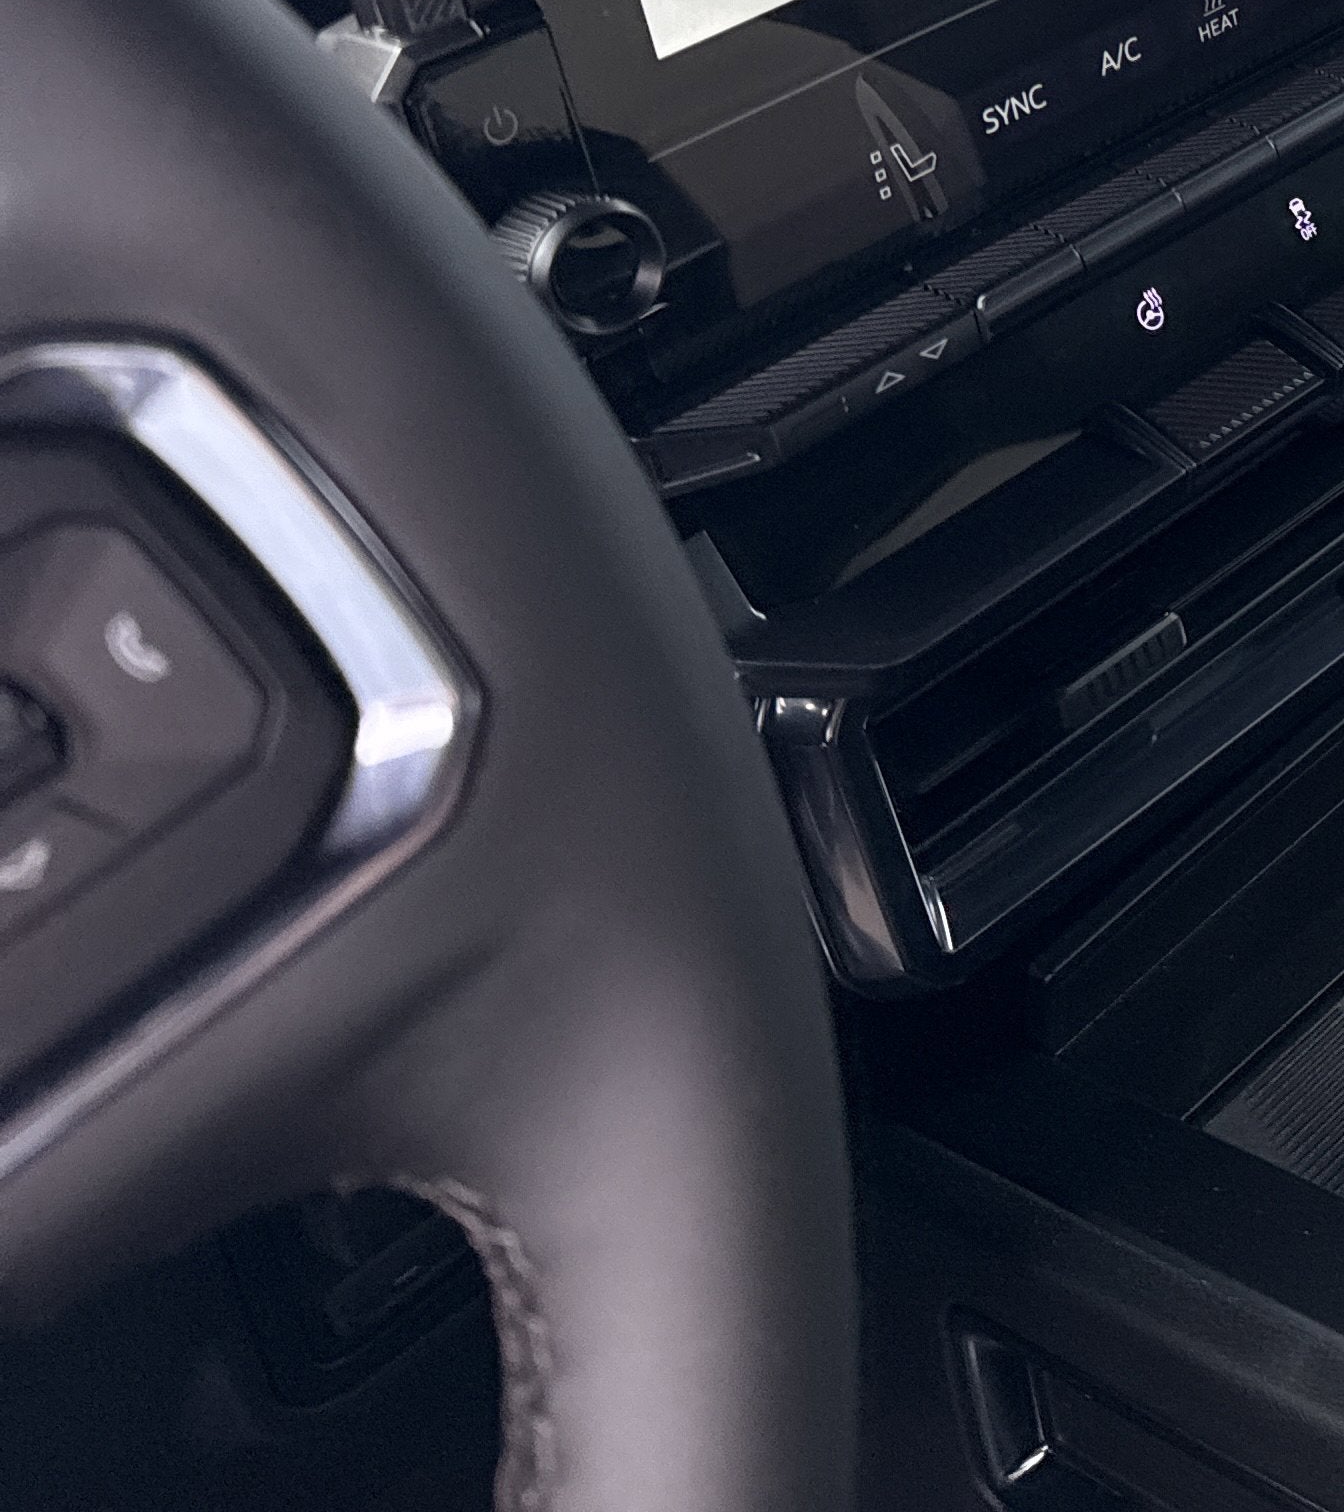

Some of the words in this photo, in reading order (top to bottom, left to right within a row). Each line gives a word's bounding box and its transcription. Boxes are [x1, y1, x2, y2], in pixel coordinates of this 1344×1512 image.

[1198, 8, 1238, 42] HEAT
[1102, 37, 1141, 76] A/C
[983, 84, 1046, 134] SYNC
